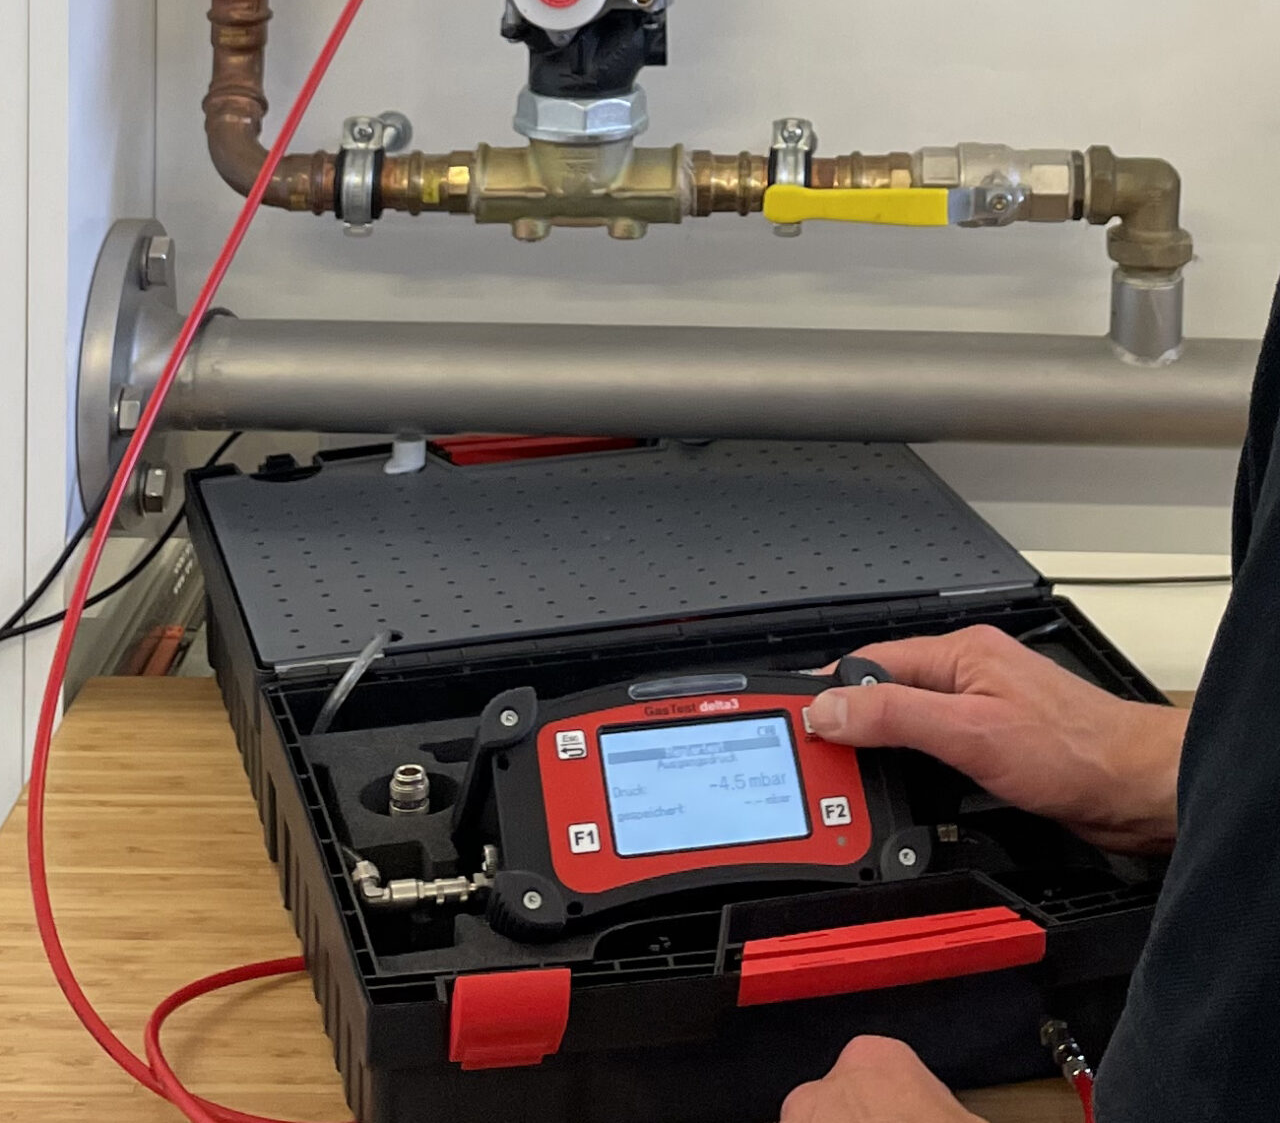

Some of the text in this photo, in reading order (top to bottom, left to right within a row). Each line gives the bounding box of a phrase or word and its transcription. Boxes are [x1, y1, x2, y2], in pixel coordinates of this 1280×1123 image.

[749, 772, 787, 788] mbar
[825, 804, 847, 819] F2
[574, 830, 595, 846] F1
